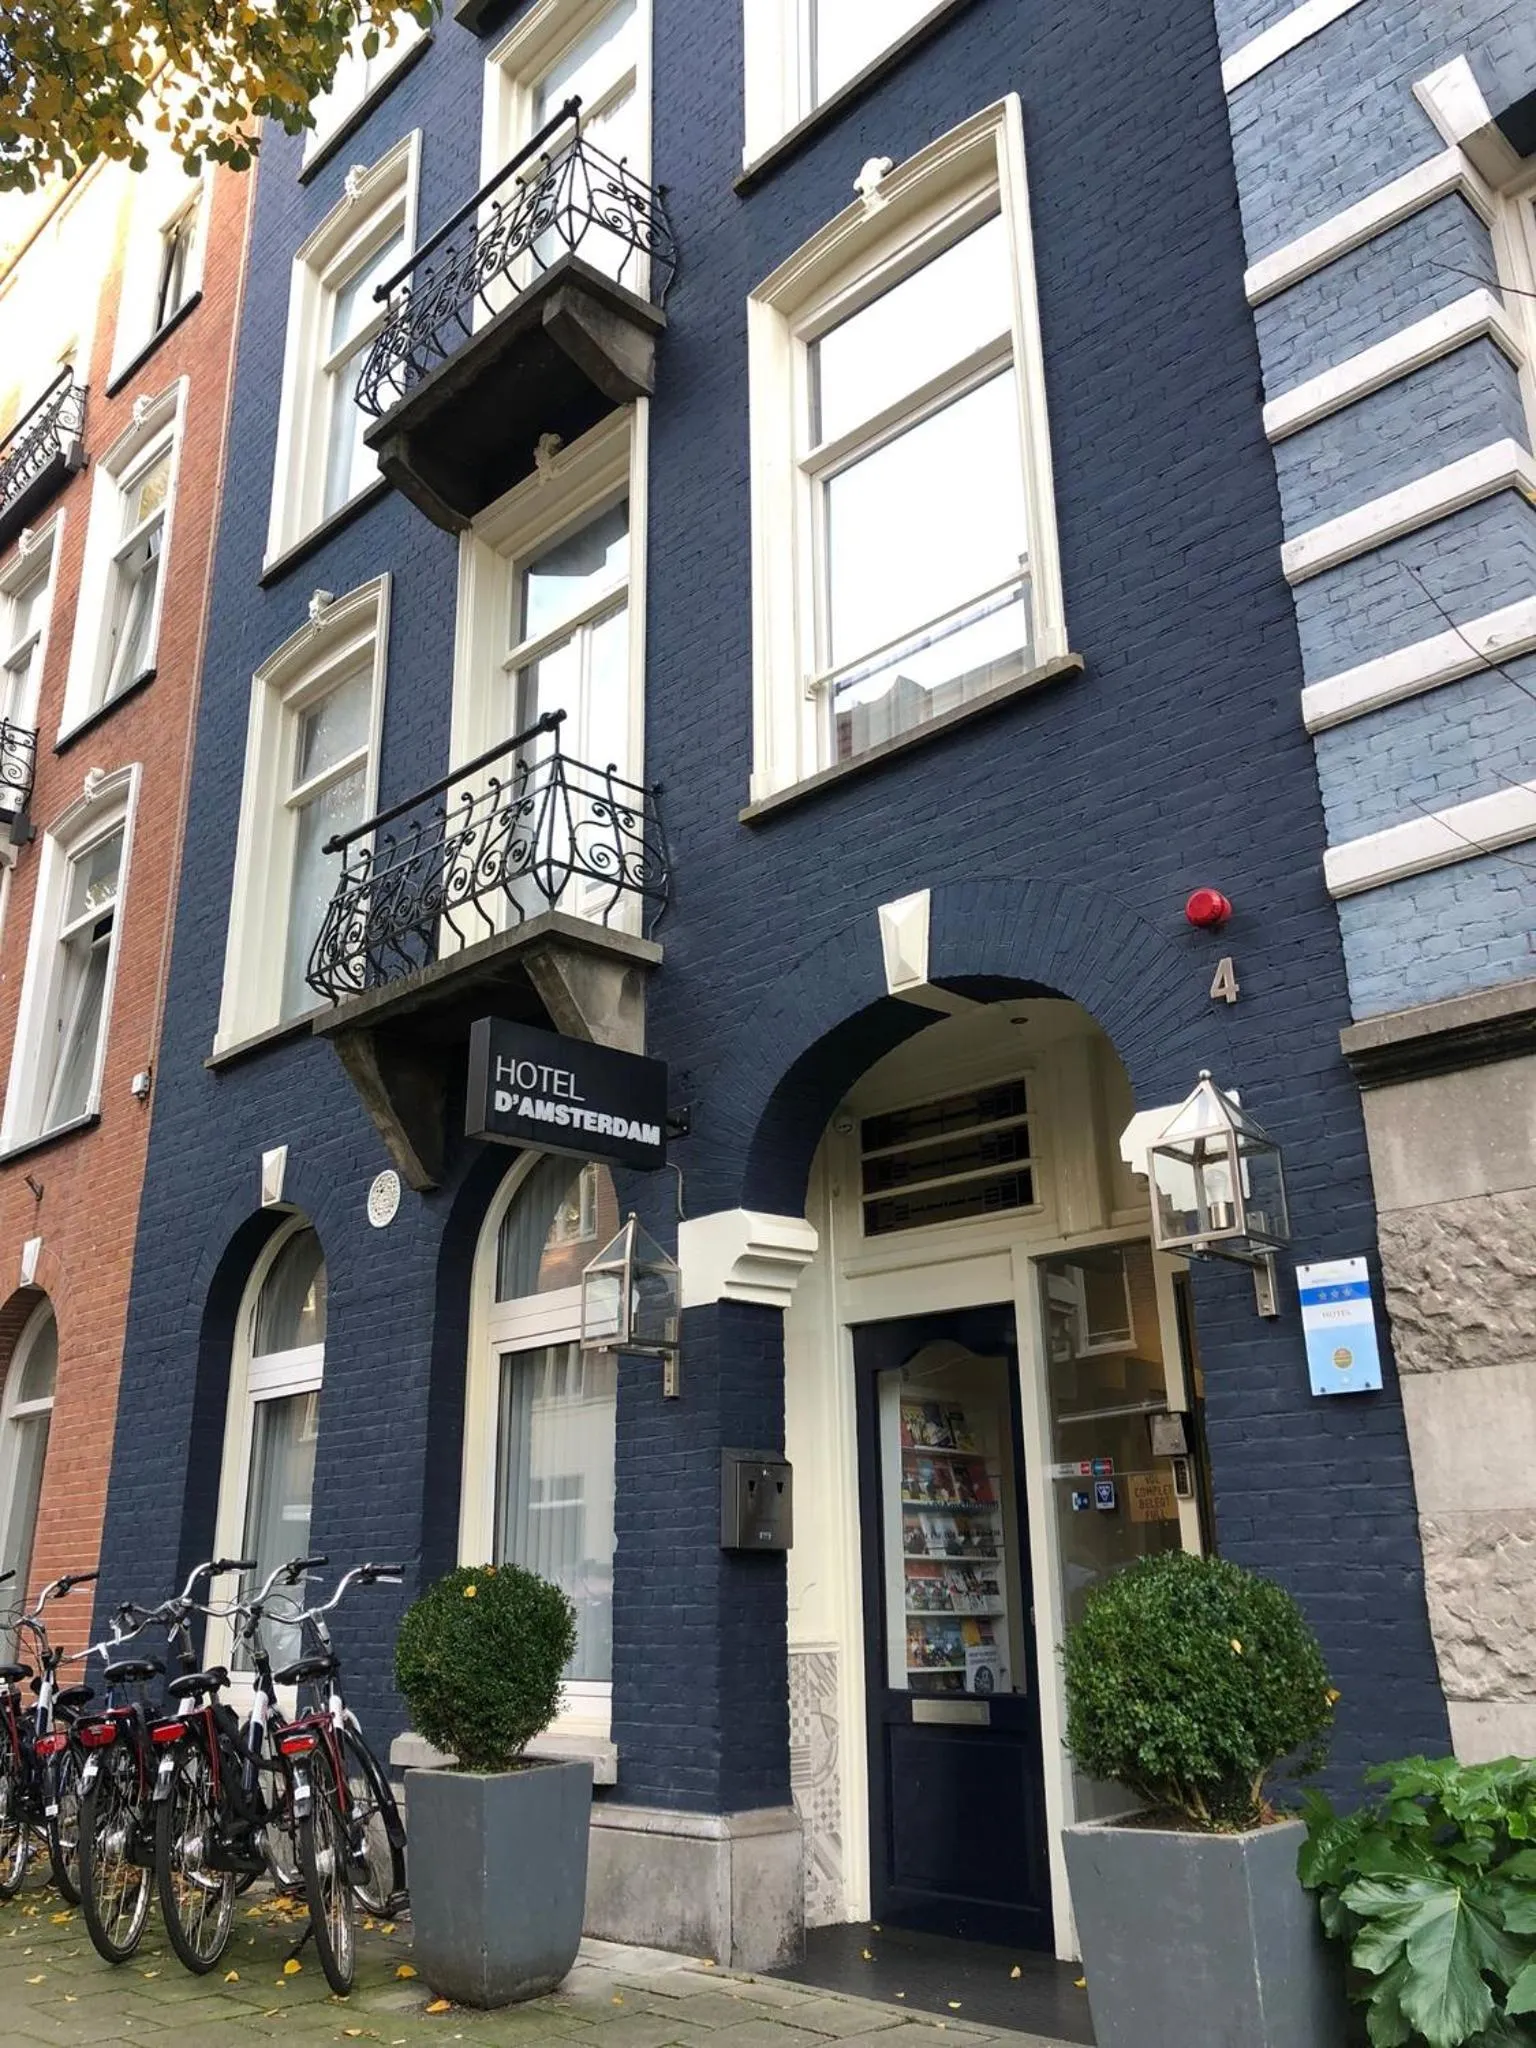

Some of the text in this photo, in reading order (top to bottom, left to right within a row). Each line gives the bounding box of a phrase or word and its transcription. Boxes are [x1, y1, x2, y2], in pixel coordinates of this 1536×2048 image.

[1210, 956, 1240, 1003] 4
[496, 1055, 586, 1102] HOTEL
[494, 1090, 661, 1146] D'AMSTERDAM
